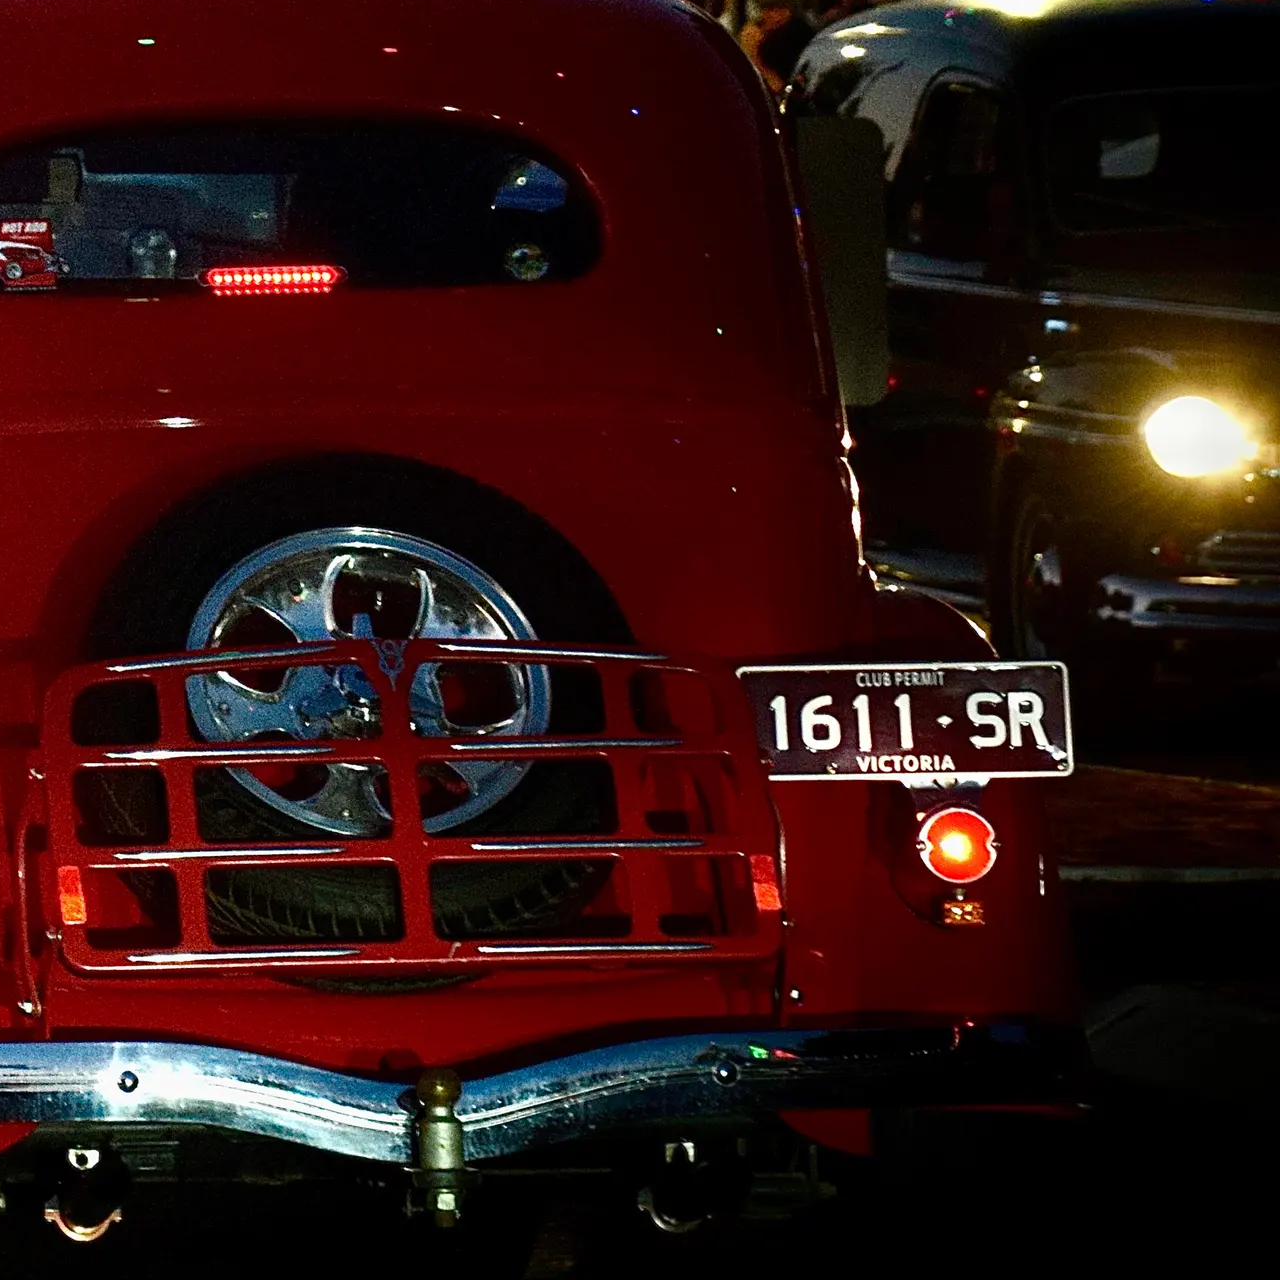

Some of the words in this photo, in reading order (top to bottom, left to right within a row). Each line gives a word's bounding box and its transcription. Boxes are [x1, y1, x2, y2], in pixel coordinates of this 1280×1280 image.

[855, 671, 892, 688] CLUB
[894, 670, 946, 687] PERMIT
[856, 754, 956, 772] VICTORIA
